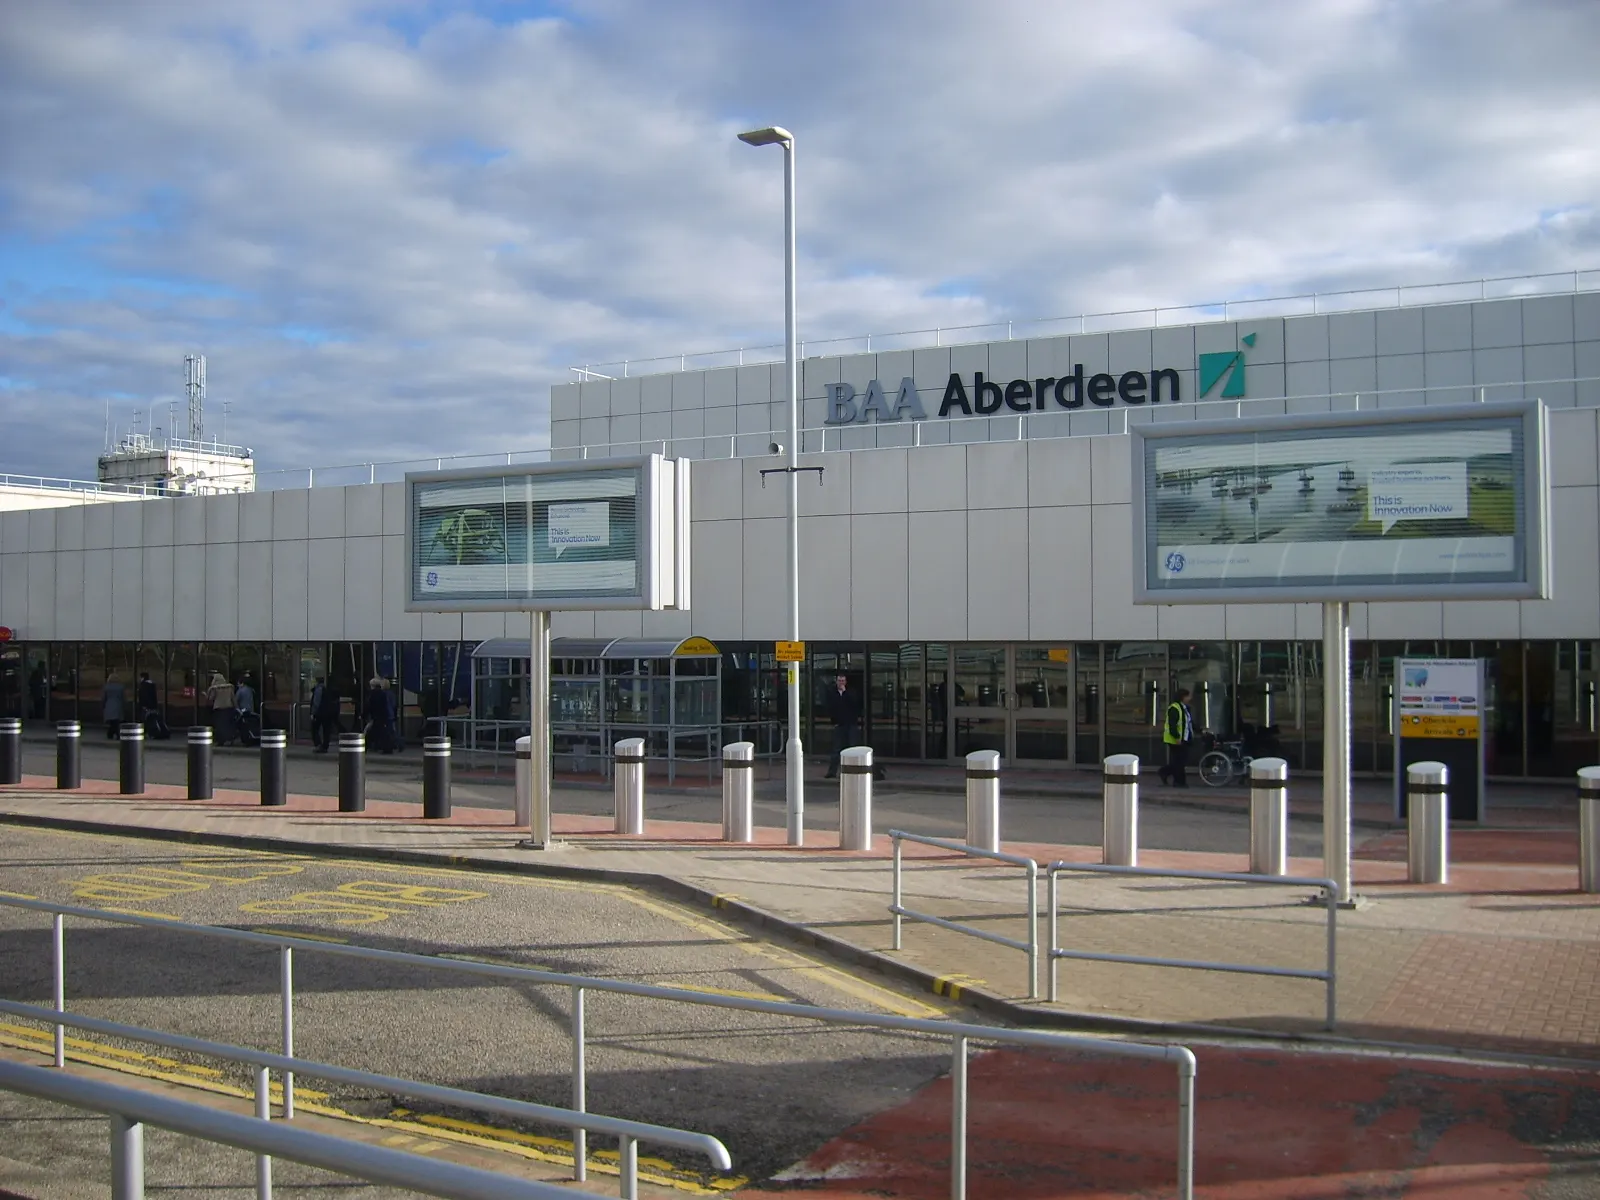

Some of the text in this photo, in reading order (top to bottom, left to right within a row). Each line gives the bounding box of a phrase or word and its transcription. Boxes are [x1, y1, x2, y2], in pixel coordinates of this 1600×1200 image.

[824, 363, 1180, 424] BAA Aberdeen
[1373, 496, 1403, 505] This is
[1374, 504, 1452, 516] Innovation Now
[551, 535, 585, 543] Innovation
[239, 880, 490, 924] BUS
